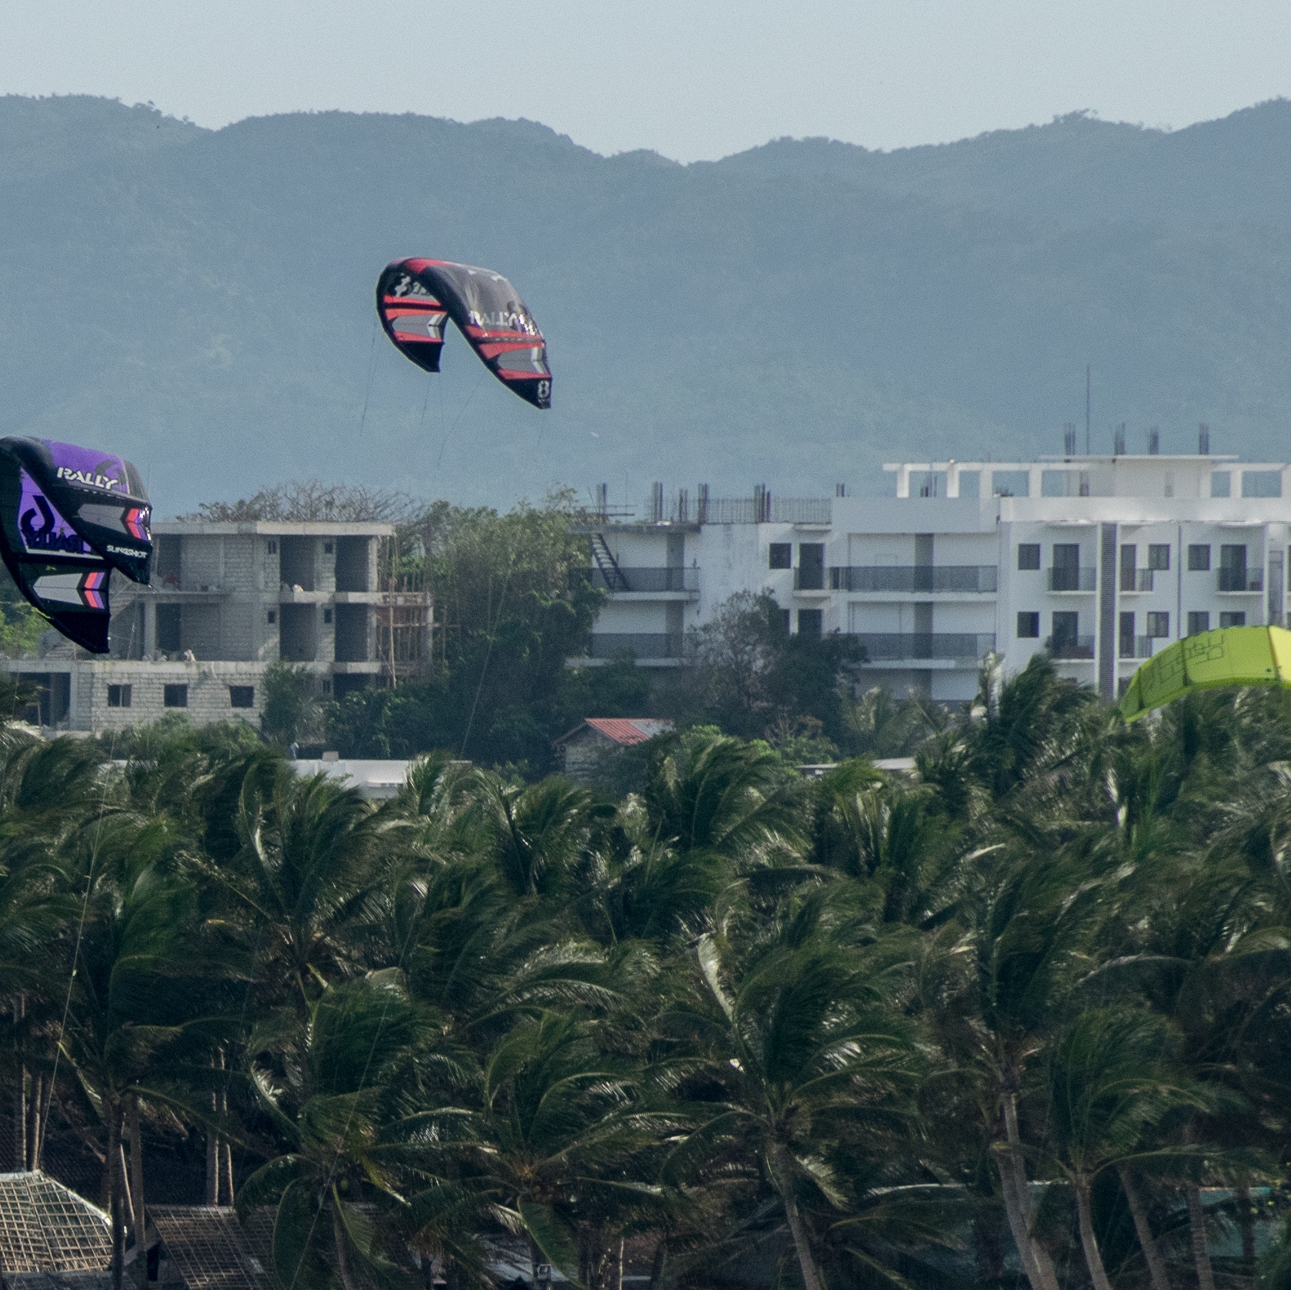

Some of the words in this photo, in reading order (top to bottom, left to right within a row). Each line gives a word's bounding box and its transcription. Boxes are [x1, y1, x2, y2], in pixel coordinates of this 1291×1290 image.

[537, 380, 550, 399] 8
[57, 467, 118, 490] RALLY
[106, 544, 148, 559] SLINGSHOT
